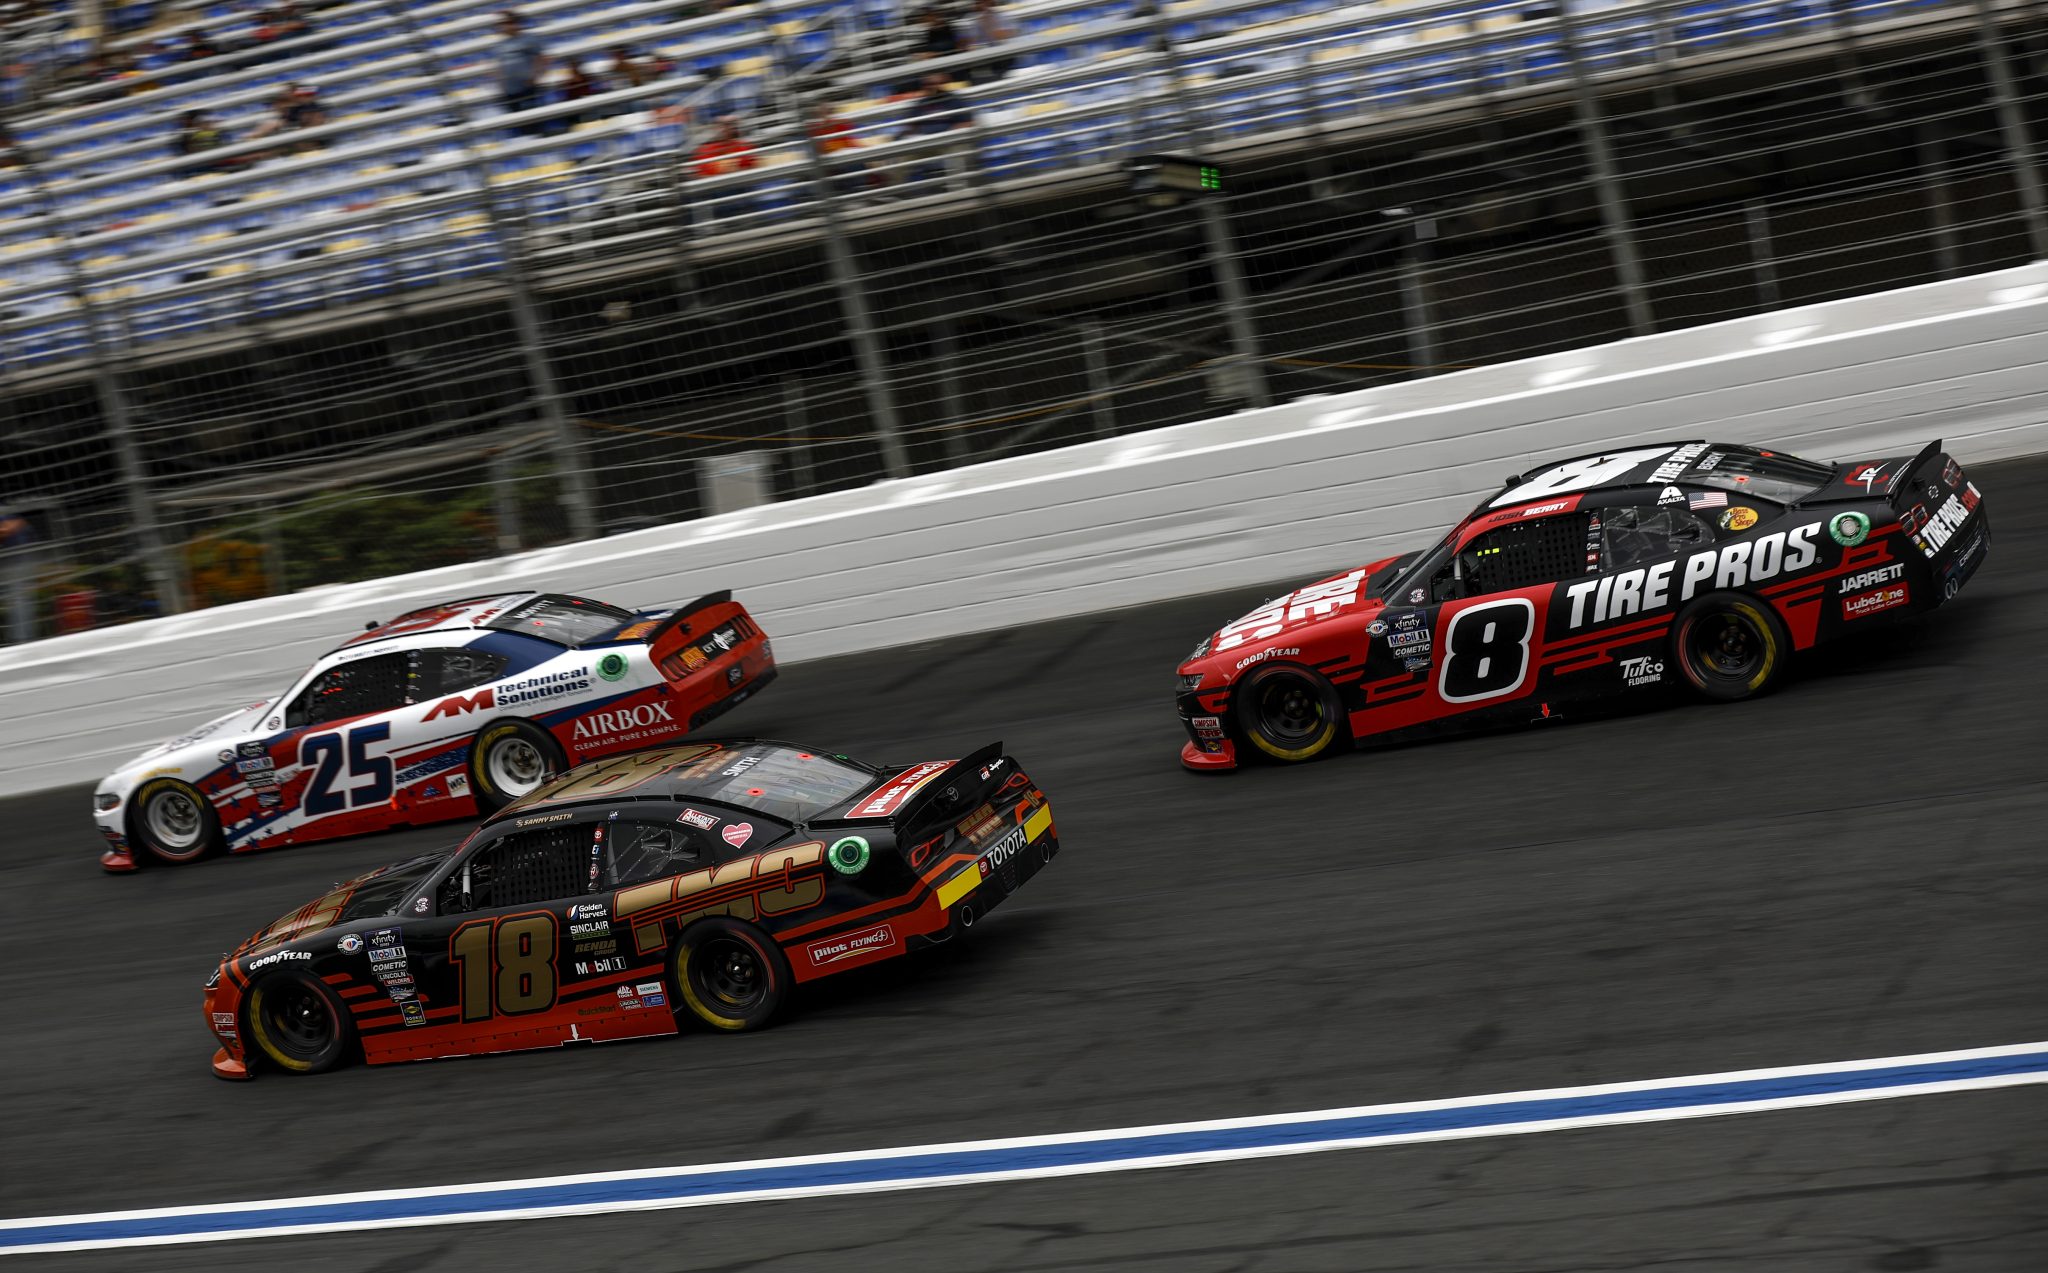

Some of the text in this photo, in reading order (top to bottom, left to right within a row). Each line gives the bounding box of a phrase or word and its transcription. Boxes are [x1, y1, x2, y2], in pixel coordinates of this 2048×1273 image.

[1523, 501, 1569, 517] BERRY
[1657, 496, 1686, 506] AXALTA
[1566, 560, 1677, 629] TIRE
[1681, 522, 1822, 602] PROS
[1838, 563, 1904, 594] JARRETT
[1846, 589, 1904, 612] LubeZone
[1395, 618, 1420, 631] xfinity
[1390, 632, 1417, 645] Mobil
[1236, 647, 1300, 670] GOODYEAR
[1395, 643, 1430, 656] COMETIC
[1438, 597, 1535, 704] 8
[1619, 656, 1664, 680] Tufco
[496, 666, 589, 694] Technical
[1628, 673, 1661, 687] FLOORING
[497, 679, 589, 706] Solutions
[420, 688, 495, 723] AM
[573, 700, 675, 740] AIRBOX
[1194, 719, 1217, 727] SIMPSON
[574, 740, 599, 751] CLEAN
[620, 731, 641, 742] PURE
[300, 720, 394, 818] 25
[722, 756, 761, 777] SMITH
[523, 812, 573, 826] SAMMY SMITH
[986, 828, 1027, 870] TOYOTA
[578, 903, 603, 913] Golden
[579, 909, 607, 920] Harvest
[570, 920, 609, 935] SINCLAIR
[371, 934, 396, 947] xfinity
[575, 939, 616, 954] RENDA
[814, 943, 848, 960] pilot
[850, 934, 879, 949] FLYING
[249, 950, 312, 971] GOODYEAR
[371, 948, 395, 960] Mobil
[372, 960, 407, 972] COMETIC
[450, 910, 559, 1023] 18
[575, 958, 612, 975] Mobil
[379, 971, 406, 981] LINCOLN
